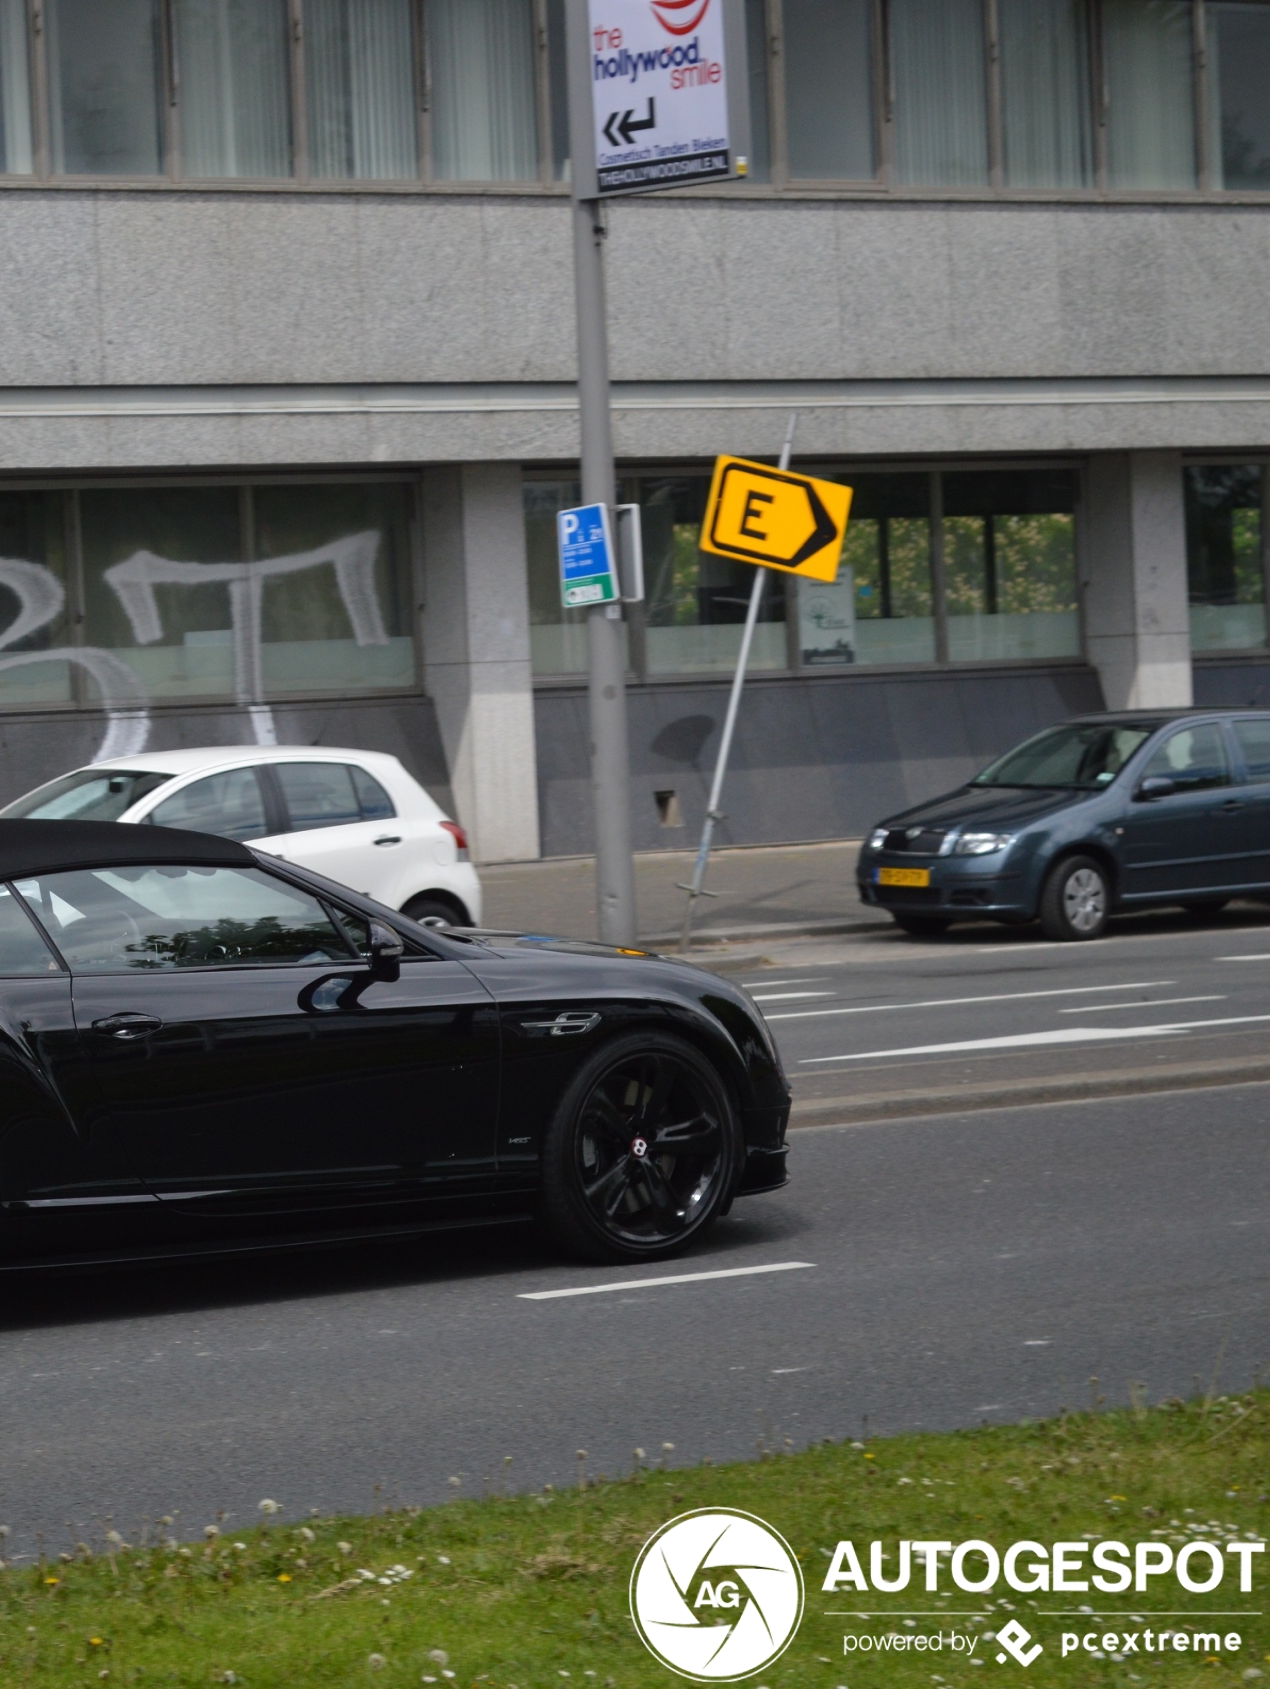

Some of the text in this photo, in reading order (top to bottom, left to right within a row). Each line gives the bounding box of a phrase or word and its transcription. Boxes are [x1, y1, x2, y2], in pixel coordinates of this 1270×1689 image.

[593, 25, 623, 51] the
[594, 36, 699, 83] hollywood
[671, 58, 722, 90] smile
[598, 137, 726, 166] Cosmetisch Tanden Bleken
[562, 514, 579, 545] P
[739, 489, 775, 541] E
